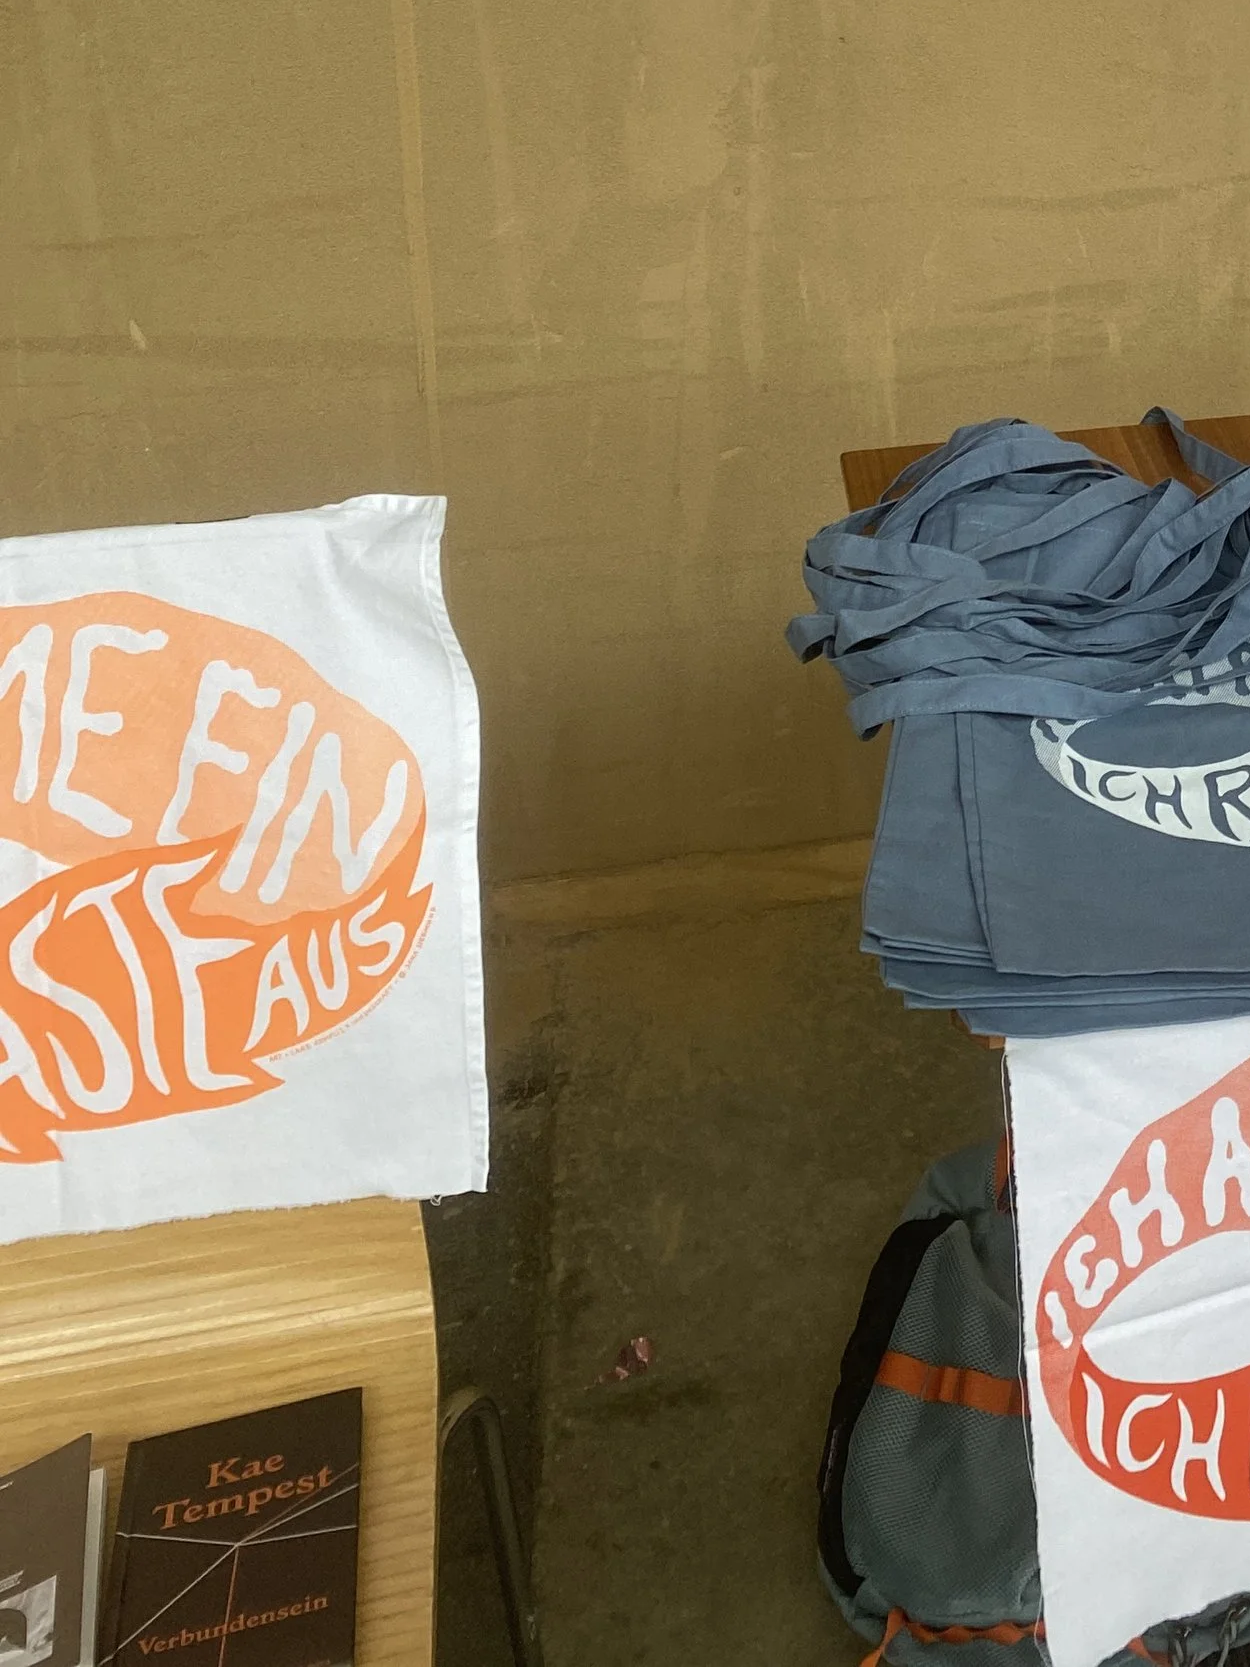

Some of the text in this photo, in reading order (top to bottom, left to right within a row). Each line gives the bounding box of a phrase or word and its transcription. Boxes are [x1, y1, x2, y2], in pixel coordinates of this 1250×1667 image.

[1069, 756, 1192, 829] ICH
[244, 889, 405, 1052] AUS
[152, 1465, 333, 1531] Tempest
[206, 1453, 285, 1489] Kae
[137, 1594, 329, 1655] Verbundensein
